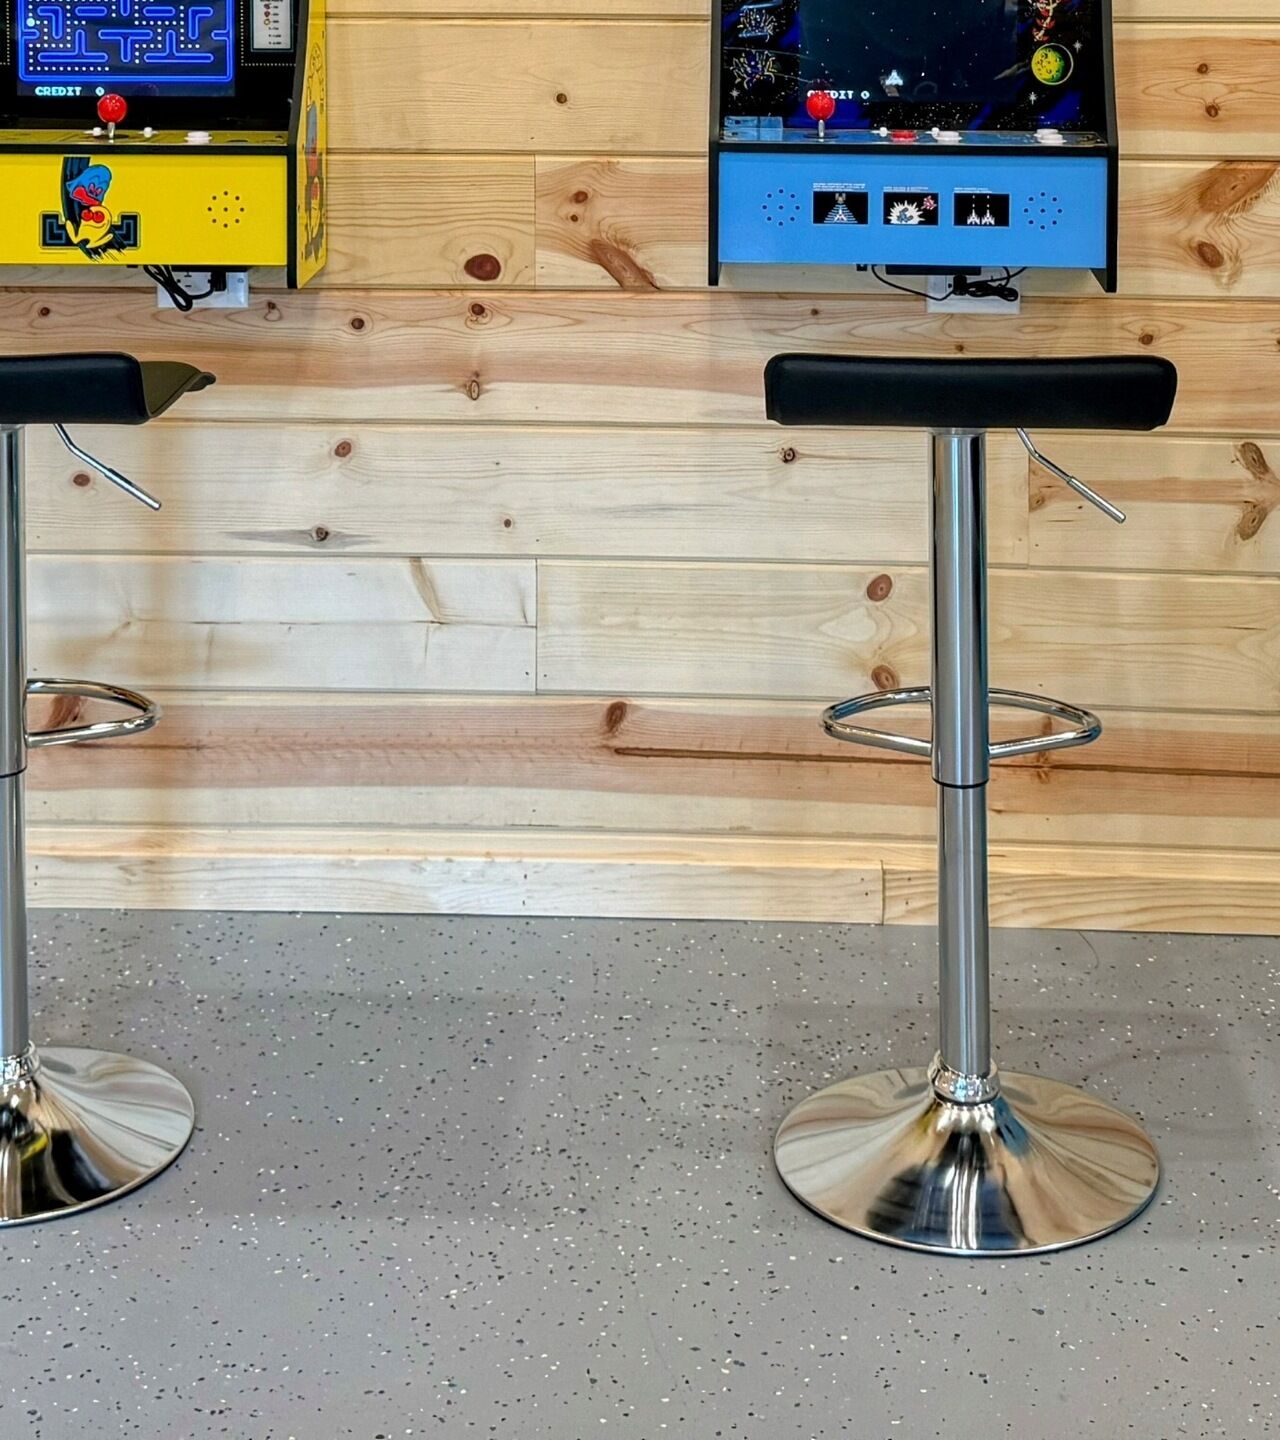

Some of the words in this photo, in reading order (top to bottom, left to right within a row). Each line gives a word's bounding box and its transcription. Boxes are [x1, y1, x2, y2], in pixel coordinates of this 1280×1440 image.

[35, 86, 82, 96] CREDIT
[95, 86, 105, 96] 0
[860, 90, 870, 100] 0
